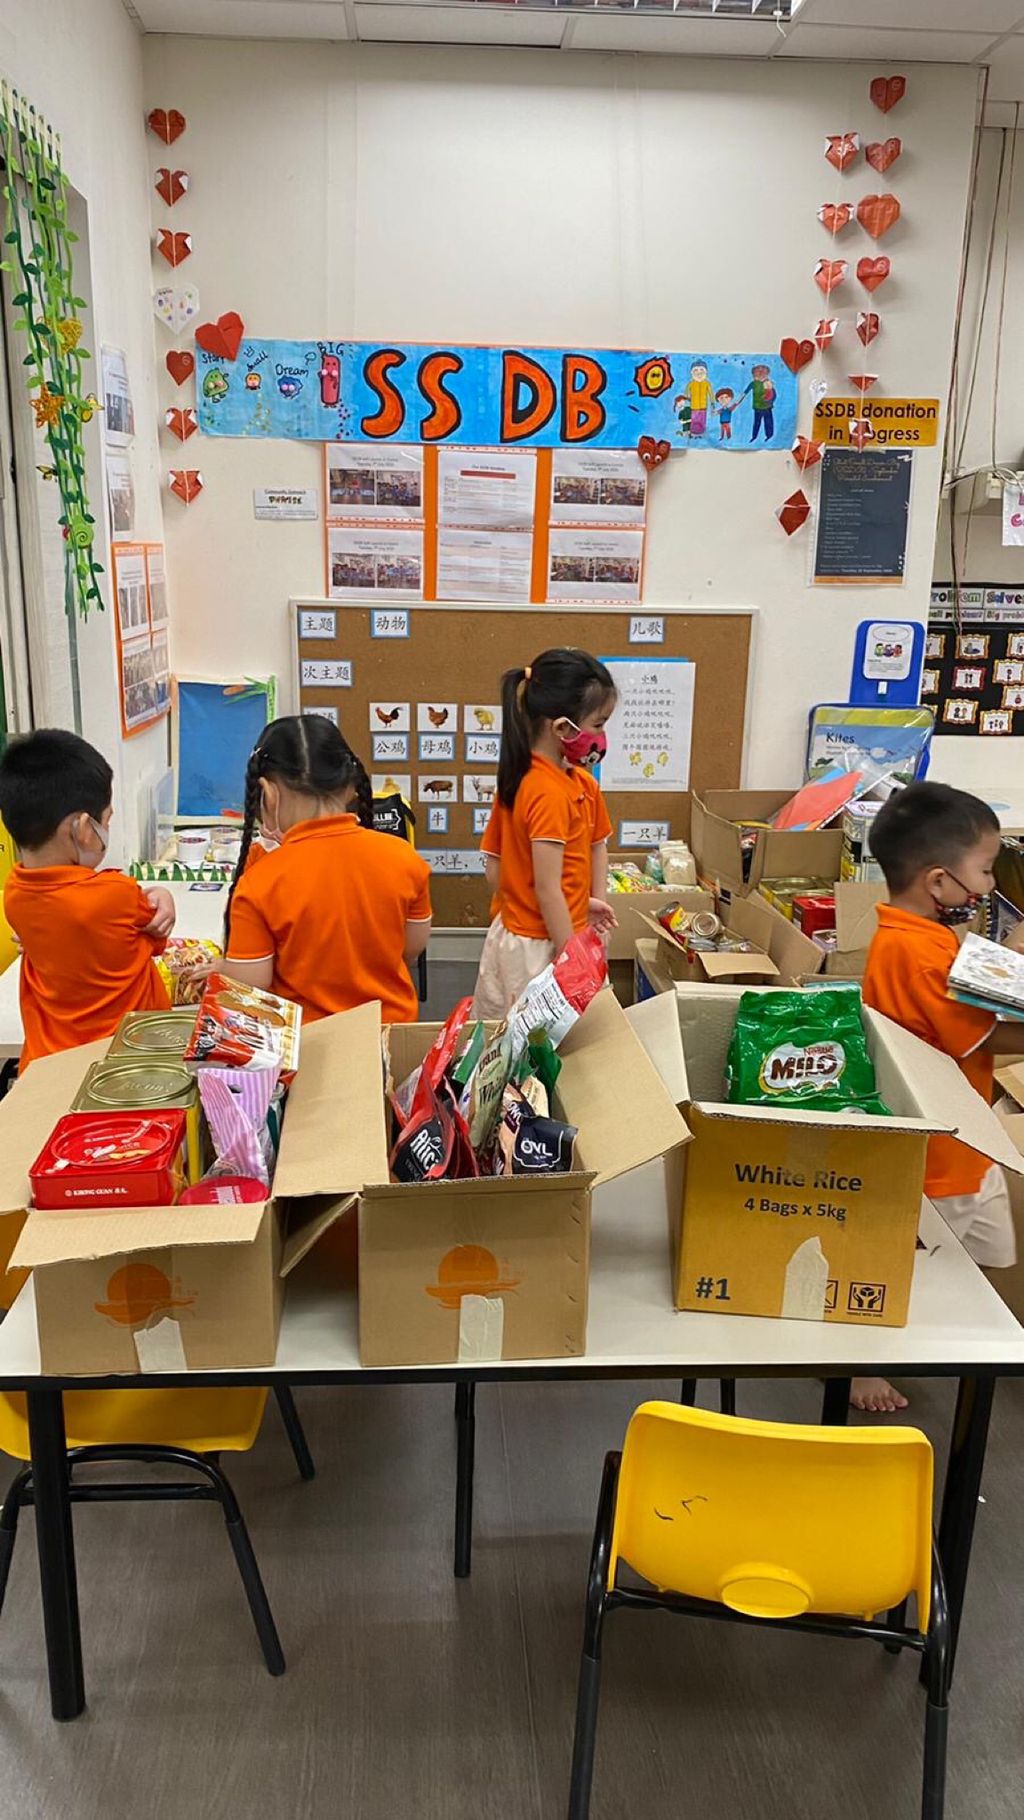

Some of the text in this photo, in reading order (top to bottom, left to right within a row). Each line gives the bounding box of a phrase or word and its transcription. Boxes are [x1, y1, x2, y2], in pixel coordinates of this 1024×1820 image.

[275, 363, 309, 377] Dream
[317, 341, 345, 358] BIG
[816, 402, 936, 418] SSDB donation
[829, 425, 843, 440] in
[987, 591, 1024, 605] Solve
[303, 616, 333, 631] 主题
[376, 616, 405, 630] 动物
[632, 621, 662, 636] 儿歌
[304, 666, 349, 680] 次主题
[826, 732, 855, 745] Kites
[376, 740, 405, 755] 公鸡
[422, 740, 451, 754] 母鸡
[469, 741, 498, 756] 小鸡
[432, 811, 444, 826] 牛
[624, 826, 667, 843] 一只羊
[770, 1055, 838, 1080] MILO
[735, 1164, 862, 1191] White Rice
[744, 1198, 847, 1221] 4 Bags x 5kg
[696, 1276, 730, 1300] #1
